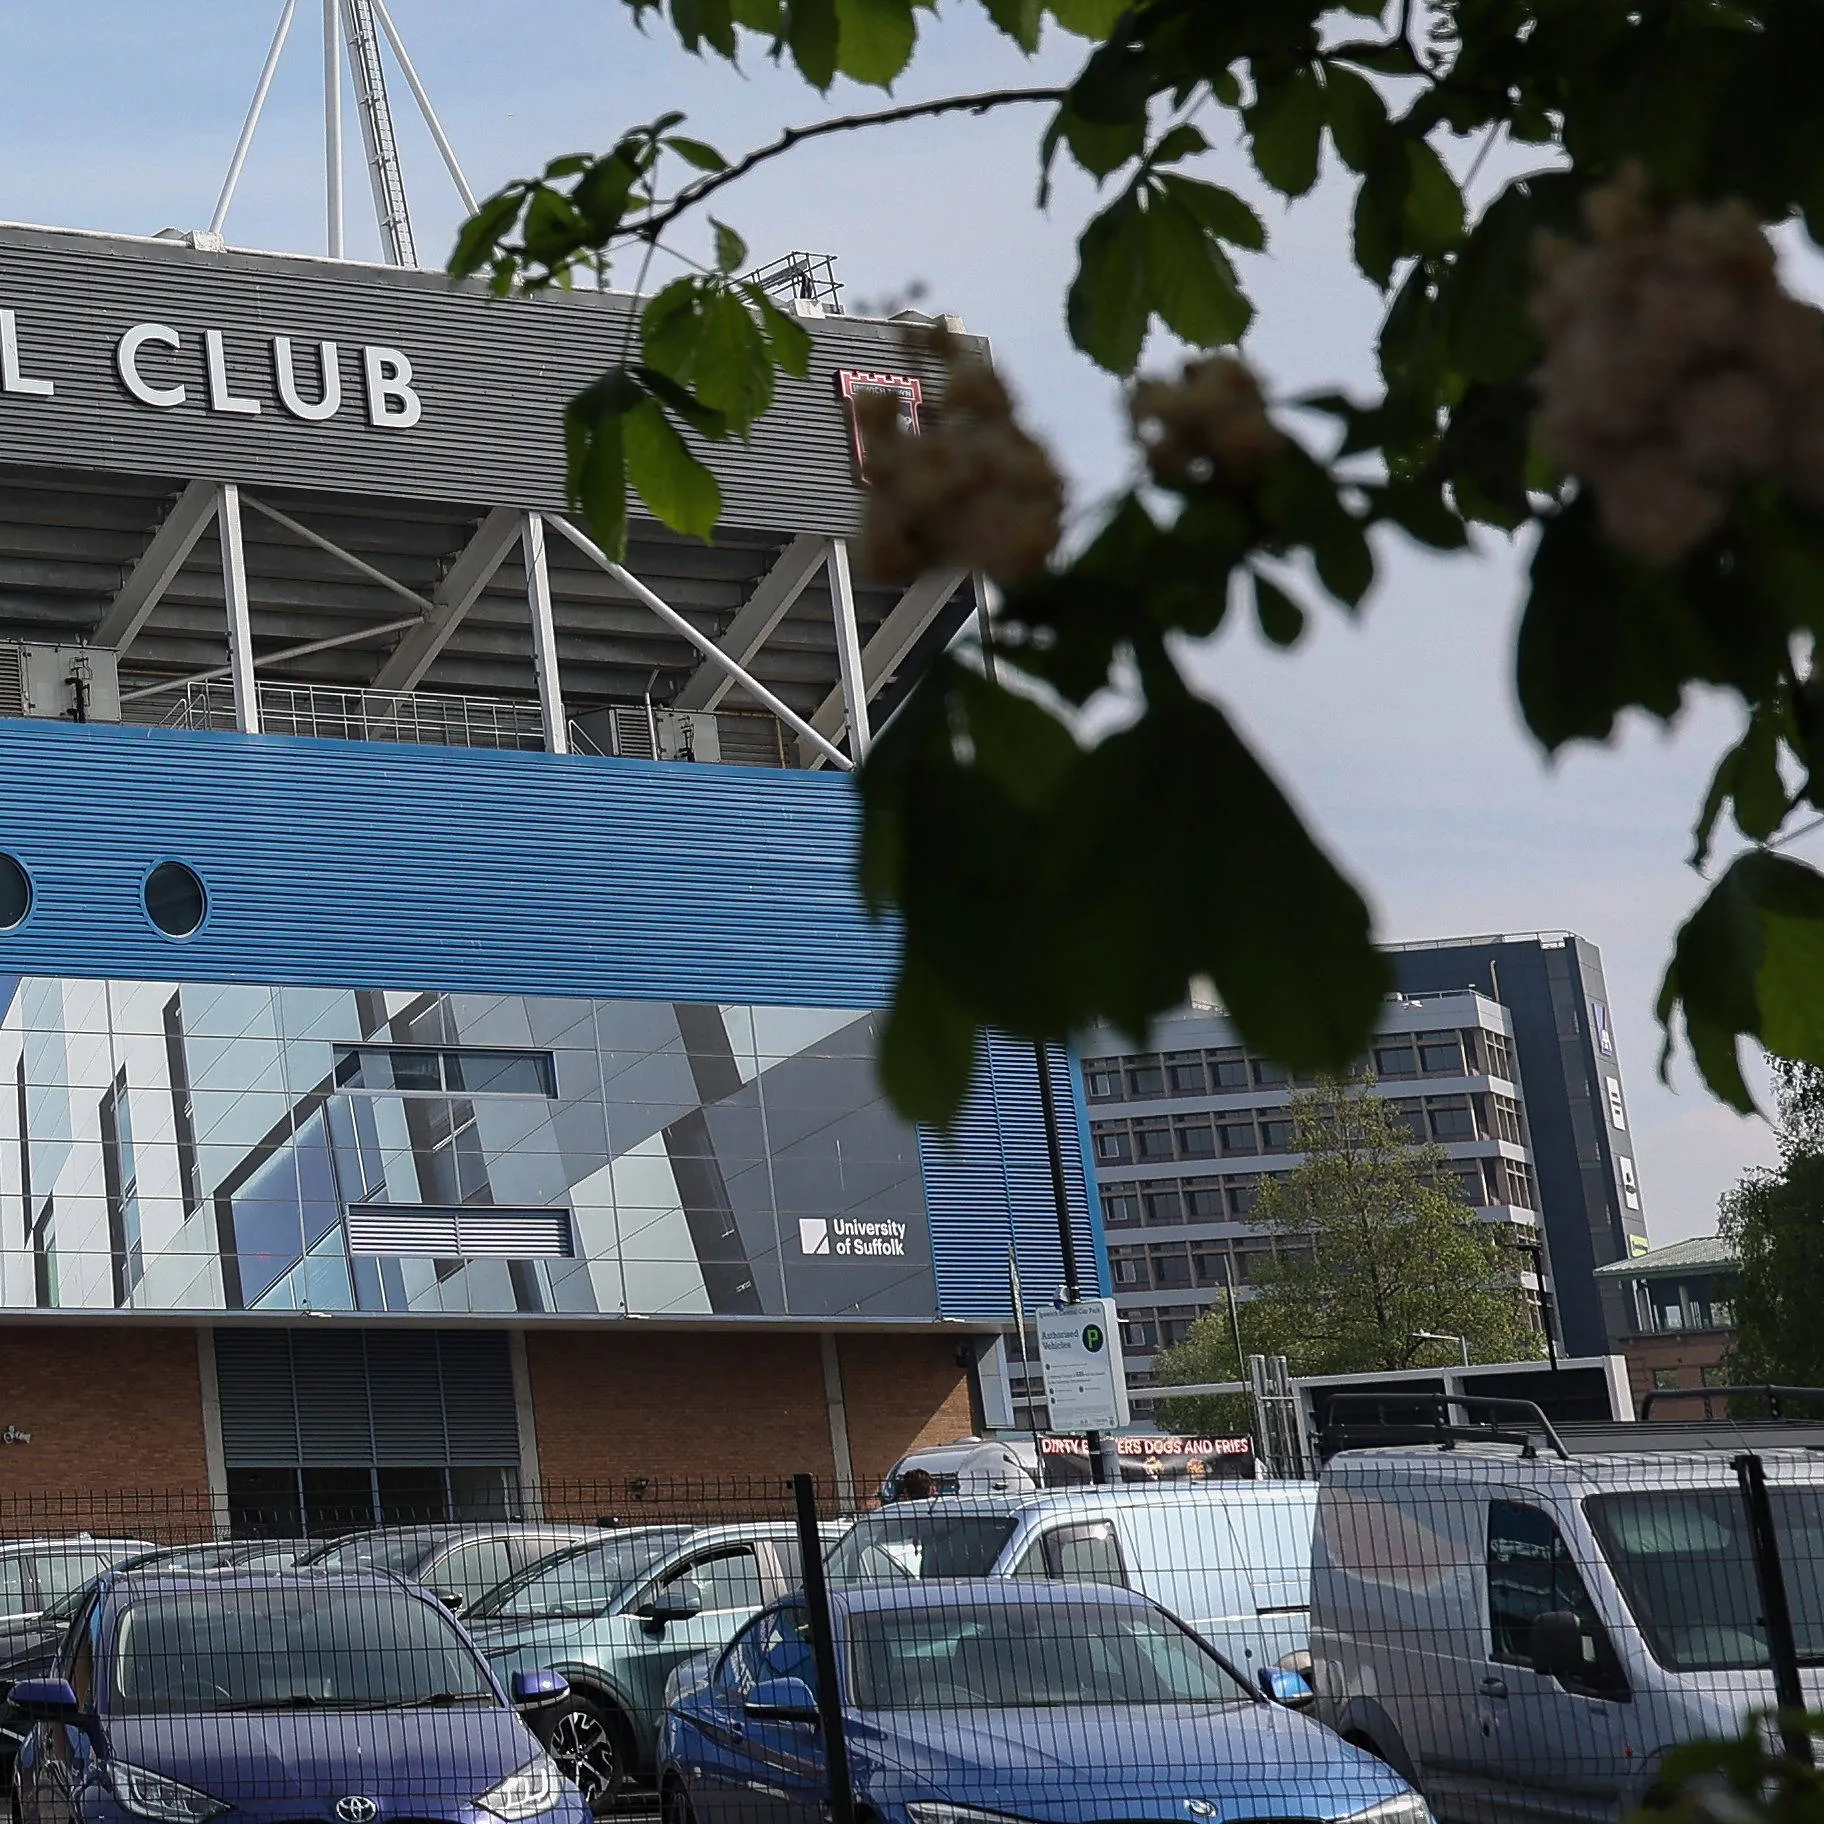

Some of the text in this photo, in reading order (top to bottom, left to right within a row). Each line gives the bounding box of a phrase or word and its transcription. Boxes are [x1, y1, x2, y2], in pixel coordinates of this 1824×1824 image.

[116, 322, 422, 429] CLUB
[833, 1218, 906, 1239] University
[836, 1238, 904, 1256] of Suffolk
[1041, 1437, 1079, 1454] DIRTY
[1144, 1438, 1181, 1455] DOGS
[1184, 1438, 1213, 1455] AND
[1215, 1438, 1249, 1454] FRIES
